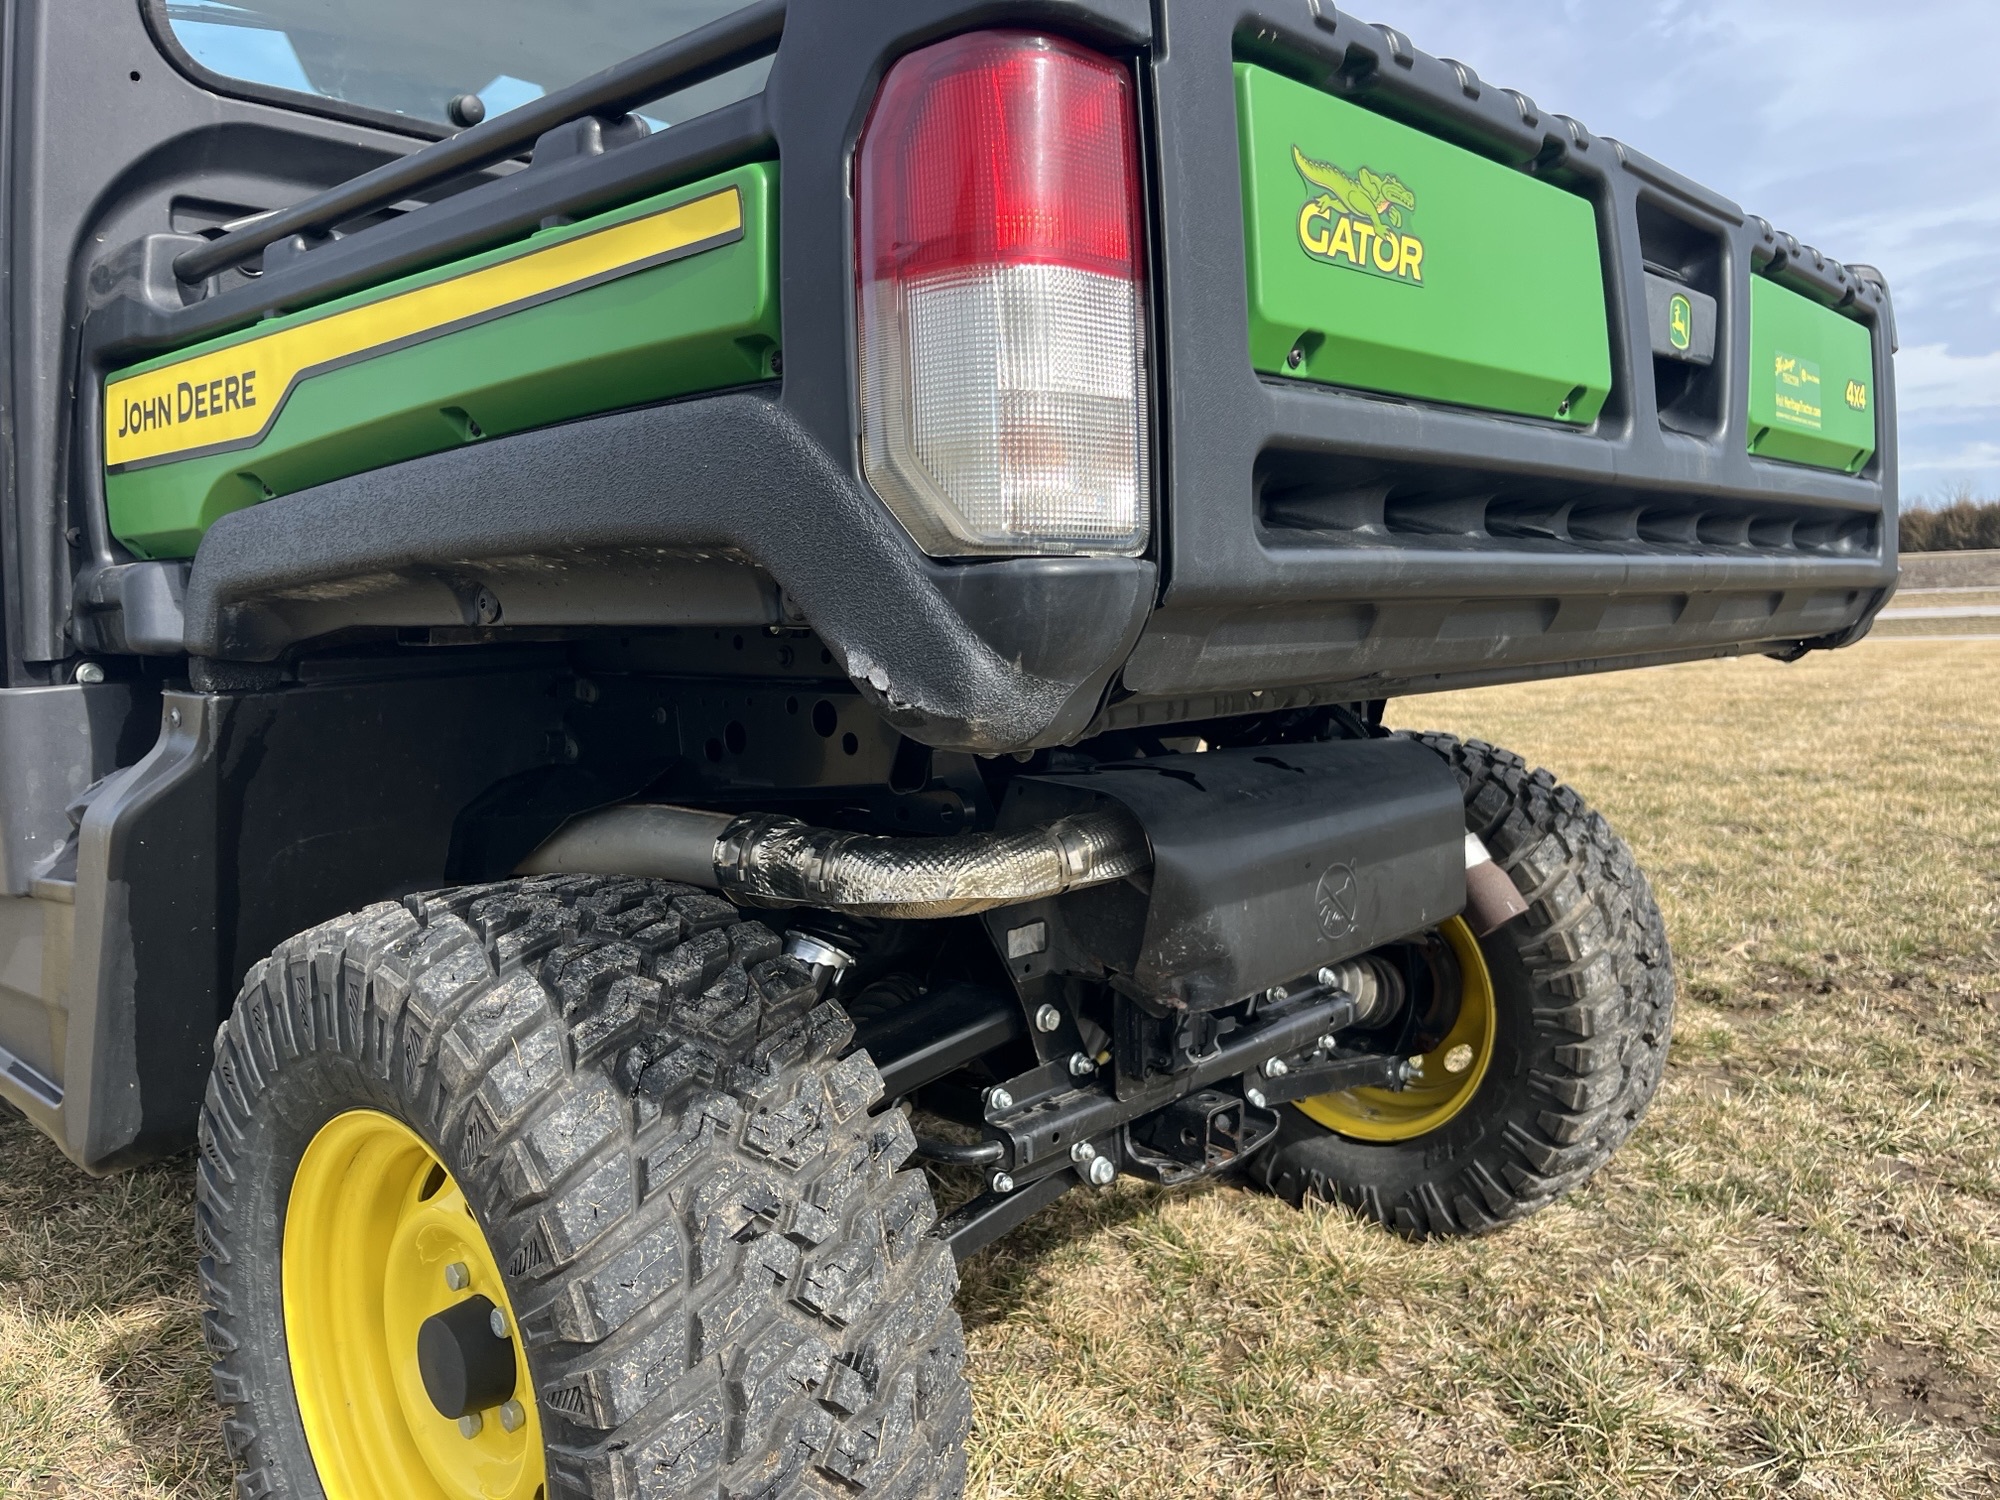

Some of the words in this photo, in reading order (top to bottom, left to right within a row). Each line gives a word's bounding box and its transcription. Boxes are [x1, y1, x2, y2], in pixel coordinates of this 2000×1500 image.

[1299, 201, 1424, 281] GATOR
[118, 393, 172, 438] JOHN
[177, 370, 257, 424] DEERE
